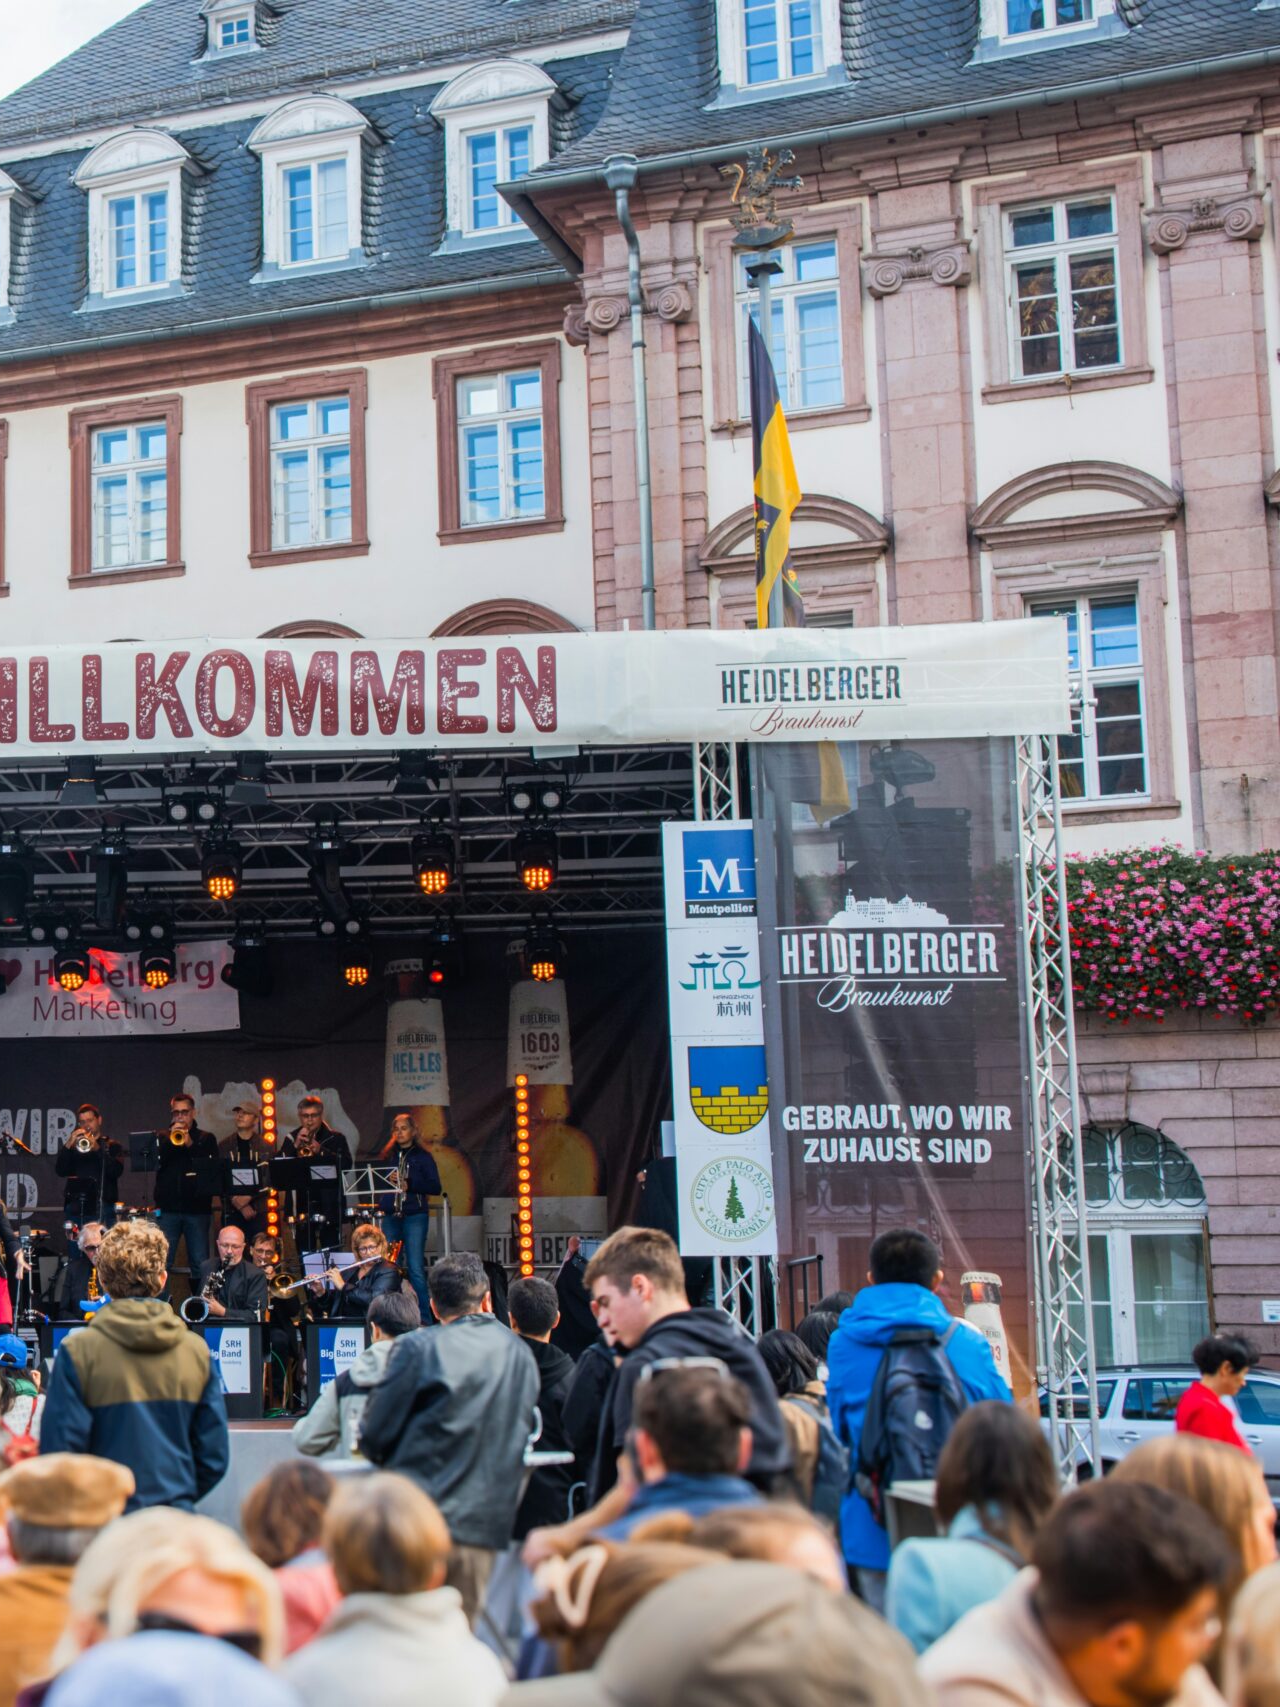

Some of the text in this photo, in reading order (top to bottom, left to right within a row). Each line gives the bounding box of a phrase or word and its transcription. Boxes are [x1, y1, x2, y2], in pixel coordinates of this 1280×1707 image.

[721, 665, 901, 704] HEIDELBERGER
[751, 705, 864, 736] Braukunst
[697, 858, 745, 894] M
[688, 903, 755, 916] Montpellier
[781, 931, 999, 976] HEIDELBERGER
[34, 959, 215, 989] Hdelrg
[816, 974, 954, 1013] Braukunst
[32, 996, 177, 1026] Marketing
[716, 1001, 752, 1017] 杭州
[520, 1032, 560, 1054] 1603
[392, 1051, 442, 1073] HELLES
[782, 1104, 1012, 1133] GEBRAUT, WO WIR
[803, 1137, 993, 1164] ZUHAUSE SIND
[695, 1175, 709, 1199] CITY
[708, 1163, 722, 1176] OF
[726, 1160, 754, 1172] PALO
[754, 1172, 773, 1199] ALTO
[705, 1218, 767, 1238] CALIFORNIA
[221, 1349, 242, 1358] Band
[225, 1339, 242, 1348] SRH
[320, 1348, 357, 1360] Big Band
[340, 1339, 357, 1348] SRH
